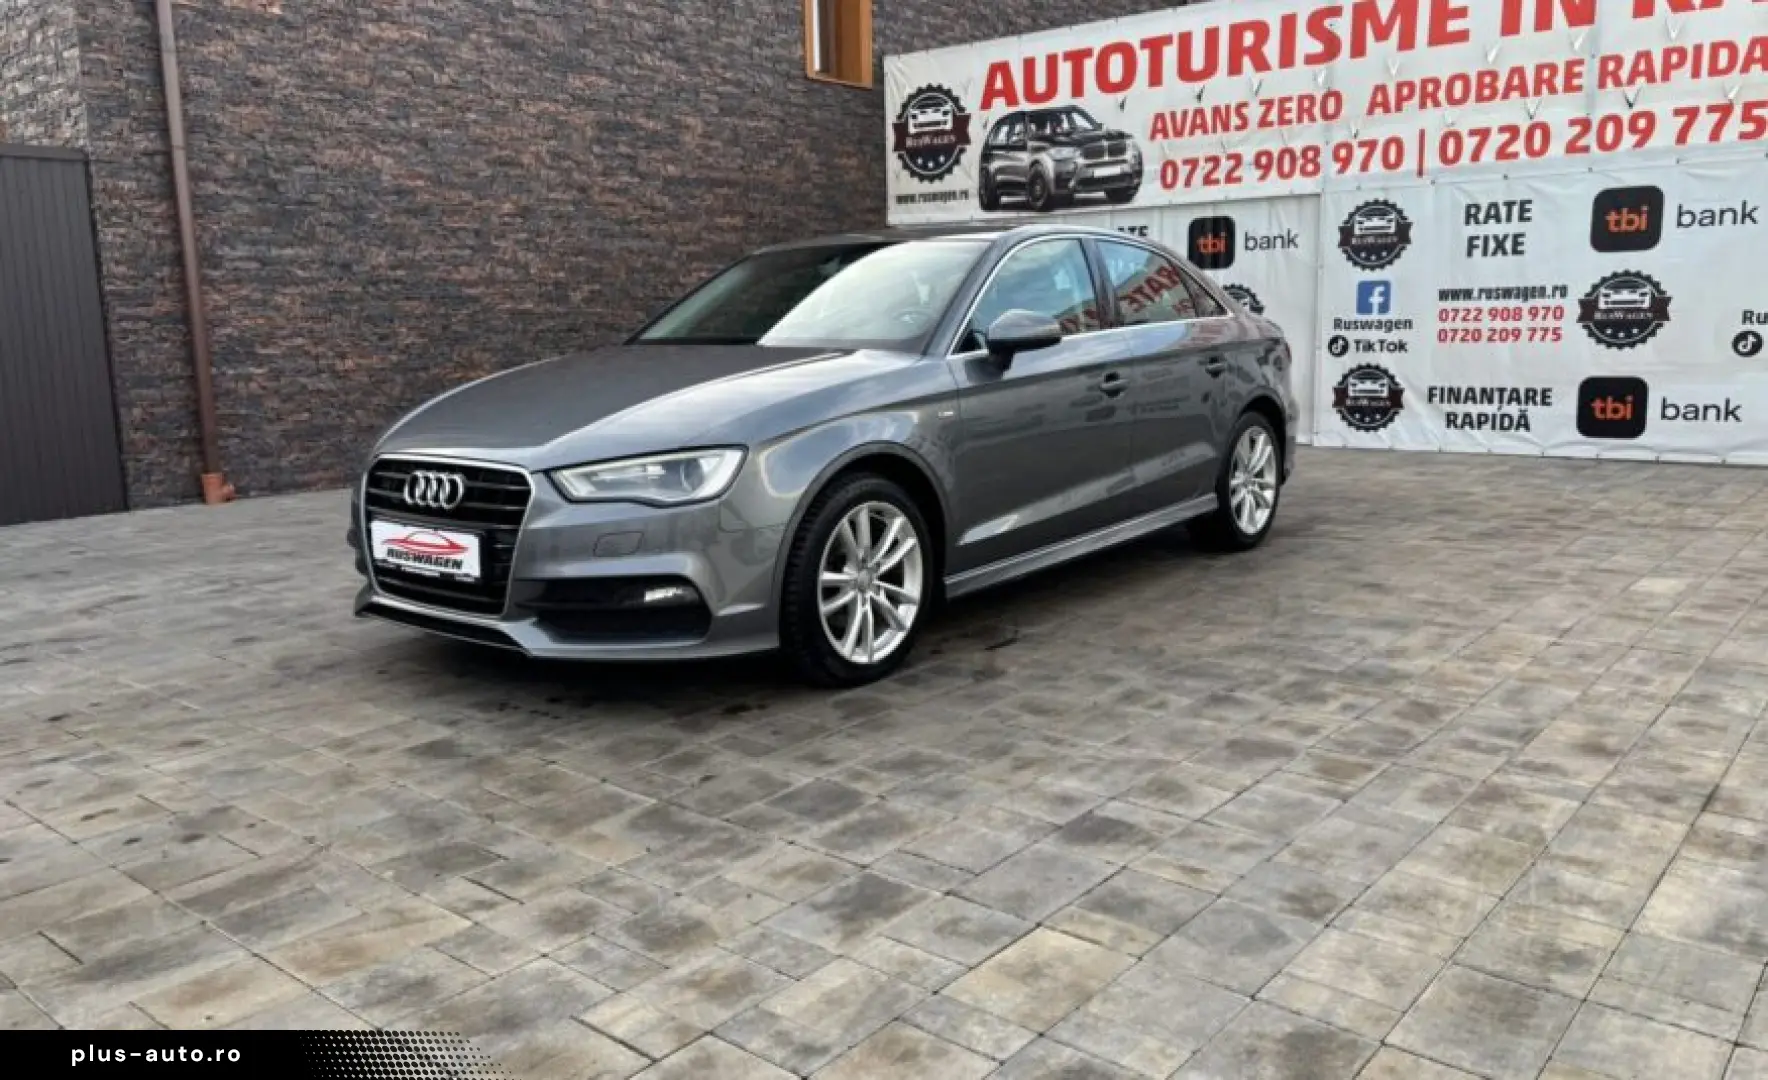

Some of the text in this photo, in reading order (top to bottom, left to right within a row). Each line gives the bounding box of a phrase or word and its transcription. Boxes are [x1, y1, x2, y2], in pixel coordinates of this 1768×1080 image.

[979, 0, 1470, 111] AUTOTURISME
[1150, 36, 1768, 140] AVANS ZERO APROBARE RAPIDA
[1160, 152, 1242, 190] 0722
[1255, 145, 1320, 181] 908
[1332, 137, 1404, 175] 970
[1438, 121, 1551, 166] 0720
[1565, 110, 1656, 154] 209
[1673, 100, 1768, 145] 775
[1464, 199, 1533, 226] RATE
[1605, 200, 1760, 233] tbi bank
[1197, 228, 1300, 254] tbi bank
[1466, 232, 1526, 258] FIXE
[1438, 284, 1569, 303] www.ruswagen.ro
[1333, 317, 1414, 333] Ruswagen
[1438, 306, 1564, 322] 0722 908 970
[1354, 339, 1408, 353] TikTok
[1438, 328, 1562, 343] 0720 209 775
[1445, 411, 1531, 433] RAPIDĂ
[1591, 395, 1744, 423] tbi bank
[387, 547, 463, 570] RUSWAGEN
